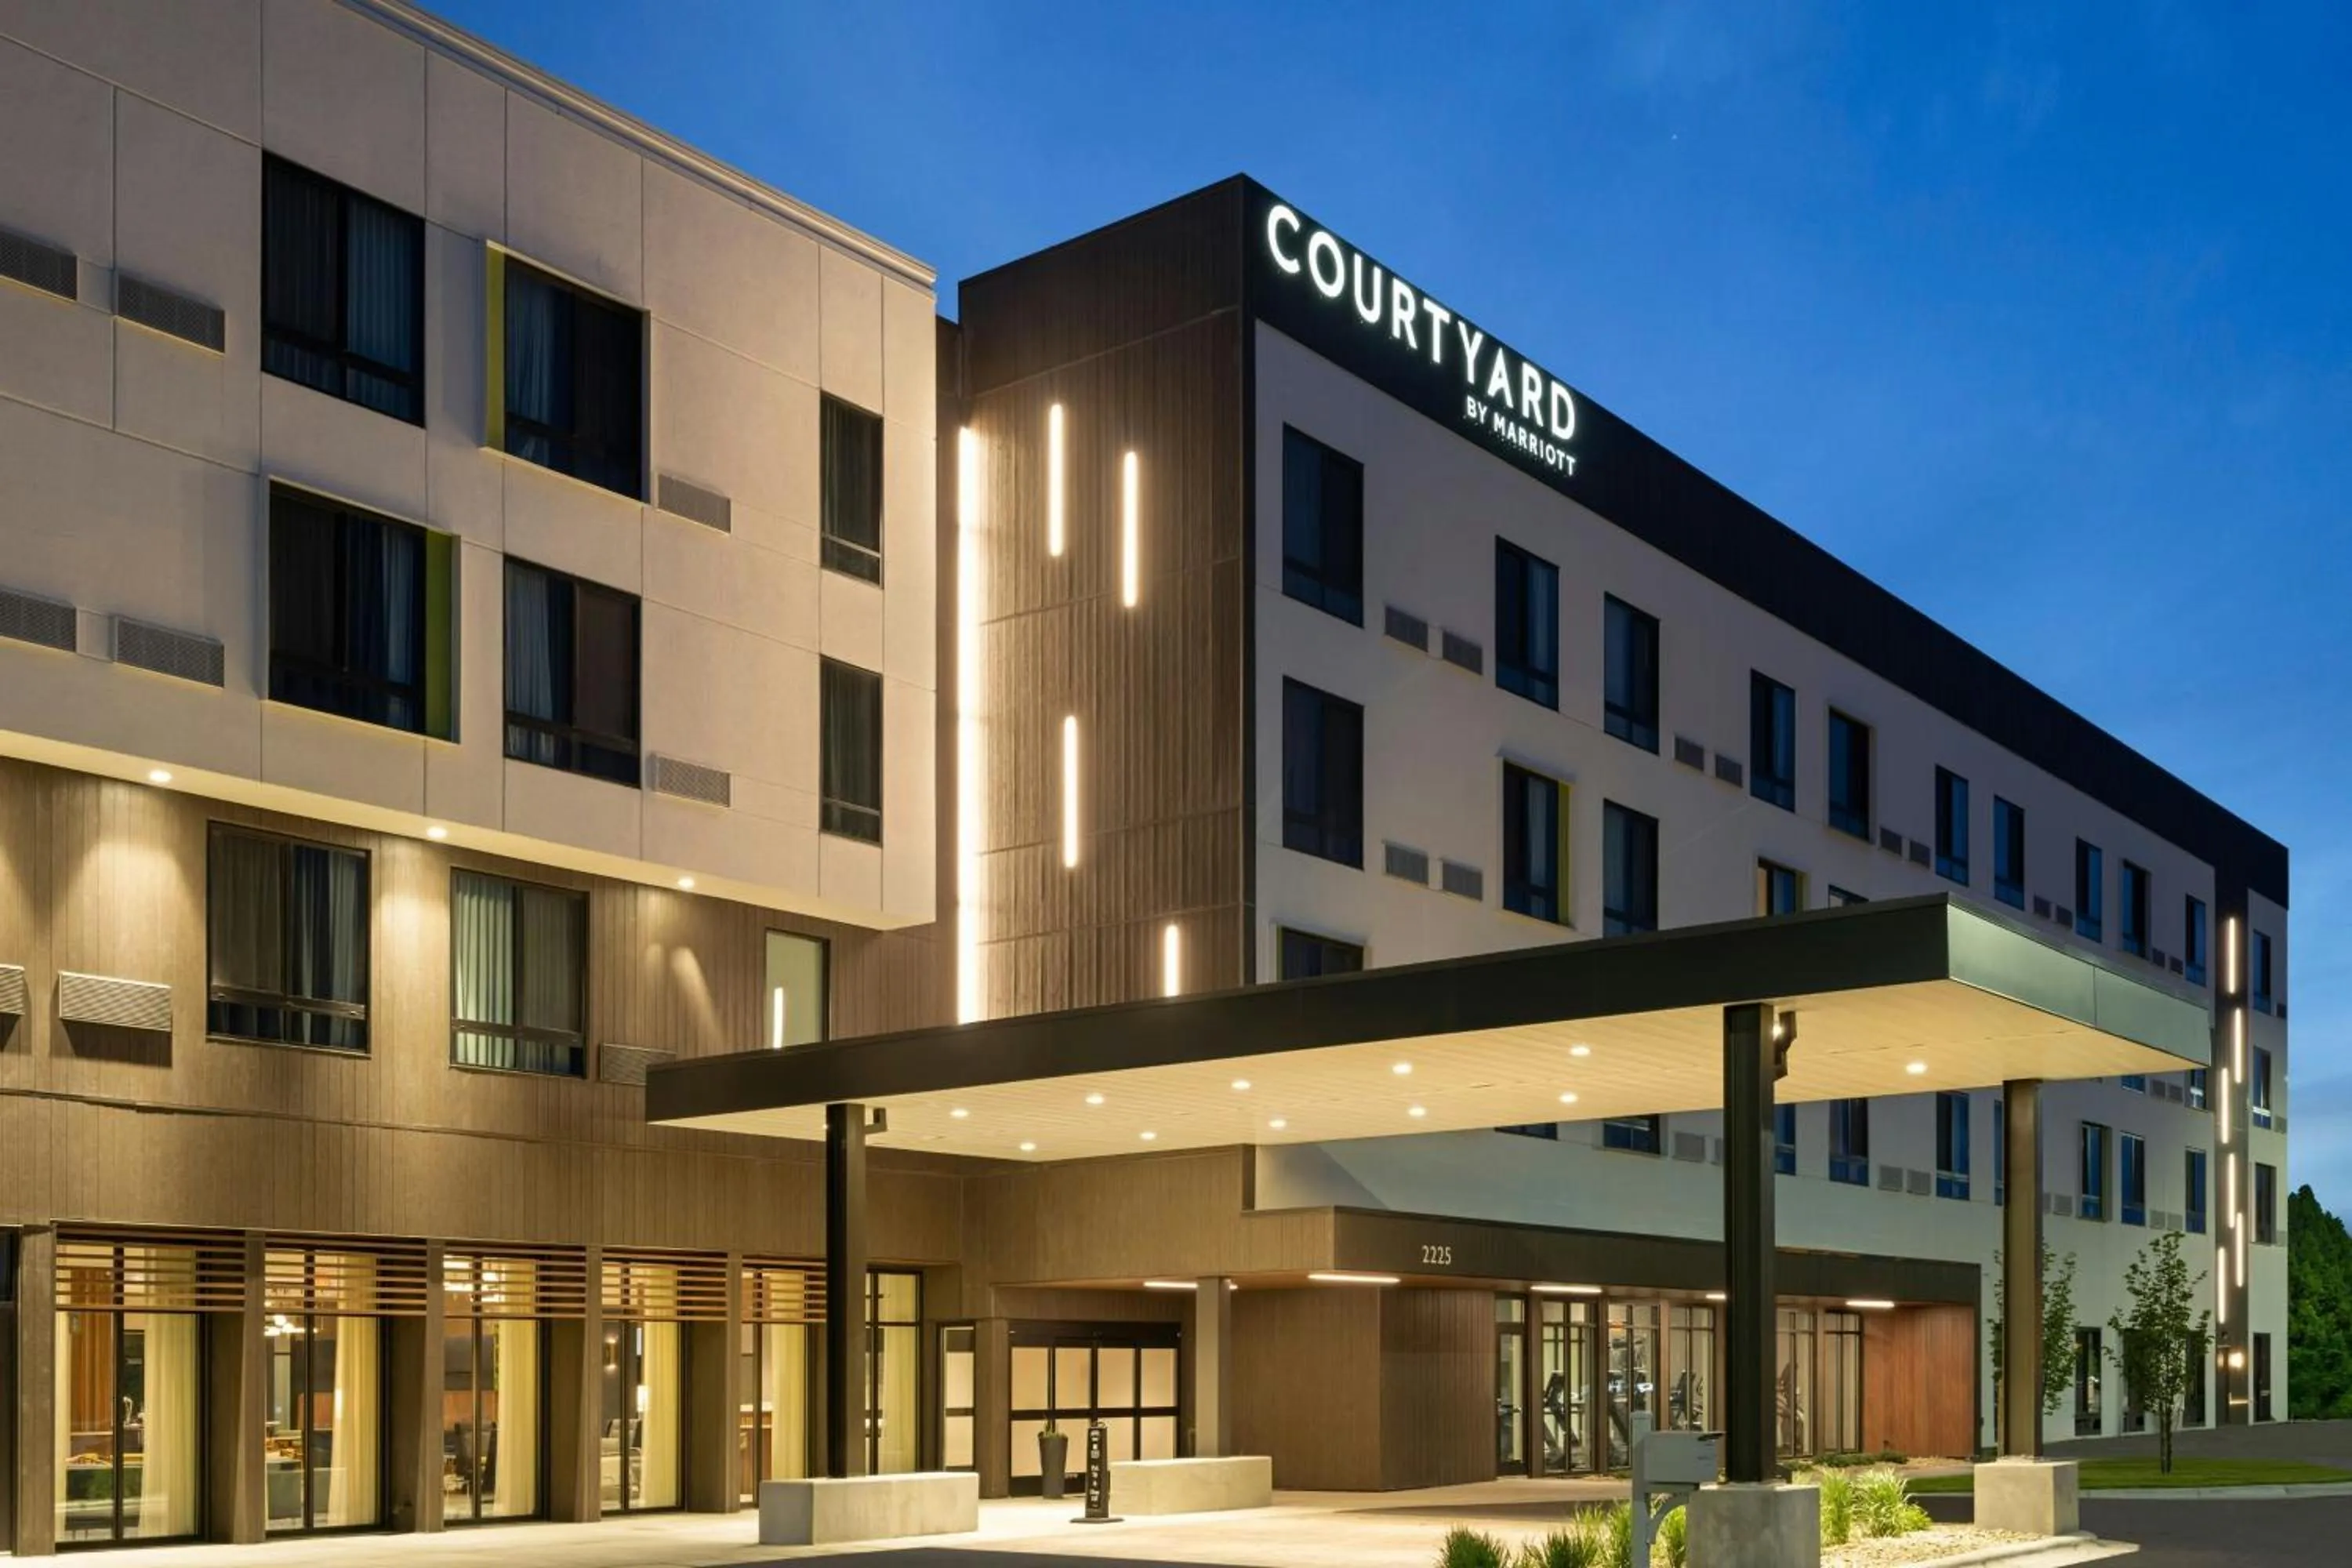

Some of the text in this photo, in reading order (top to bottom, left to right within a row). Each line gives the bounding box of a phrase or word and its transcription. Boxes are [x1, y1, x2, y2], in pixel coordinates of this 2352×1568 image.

[1267, 205, 1576, 441] COURTYARD
[1467, 395, 1577, 476] BY MARRIOTT
[1422, 1244, 1451, 1265] 2225
